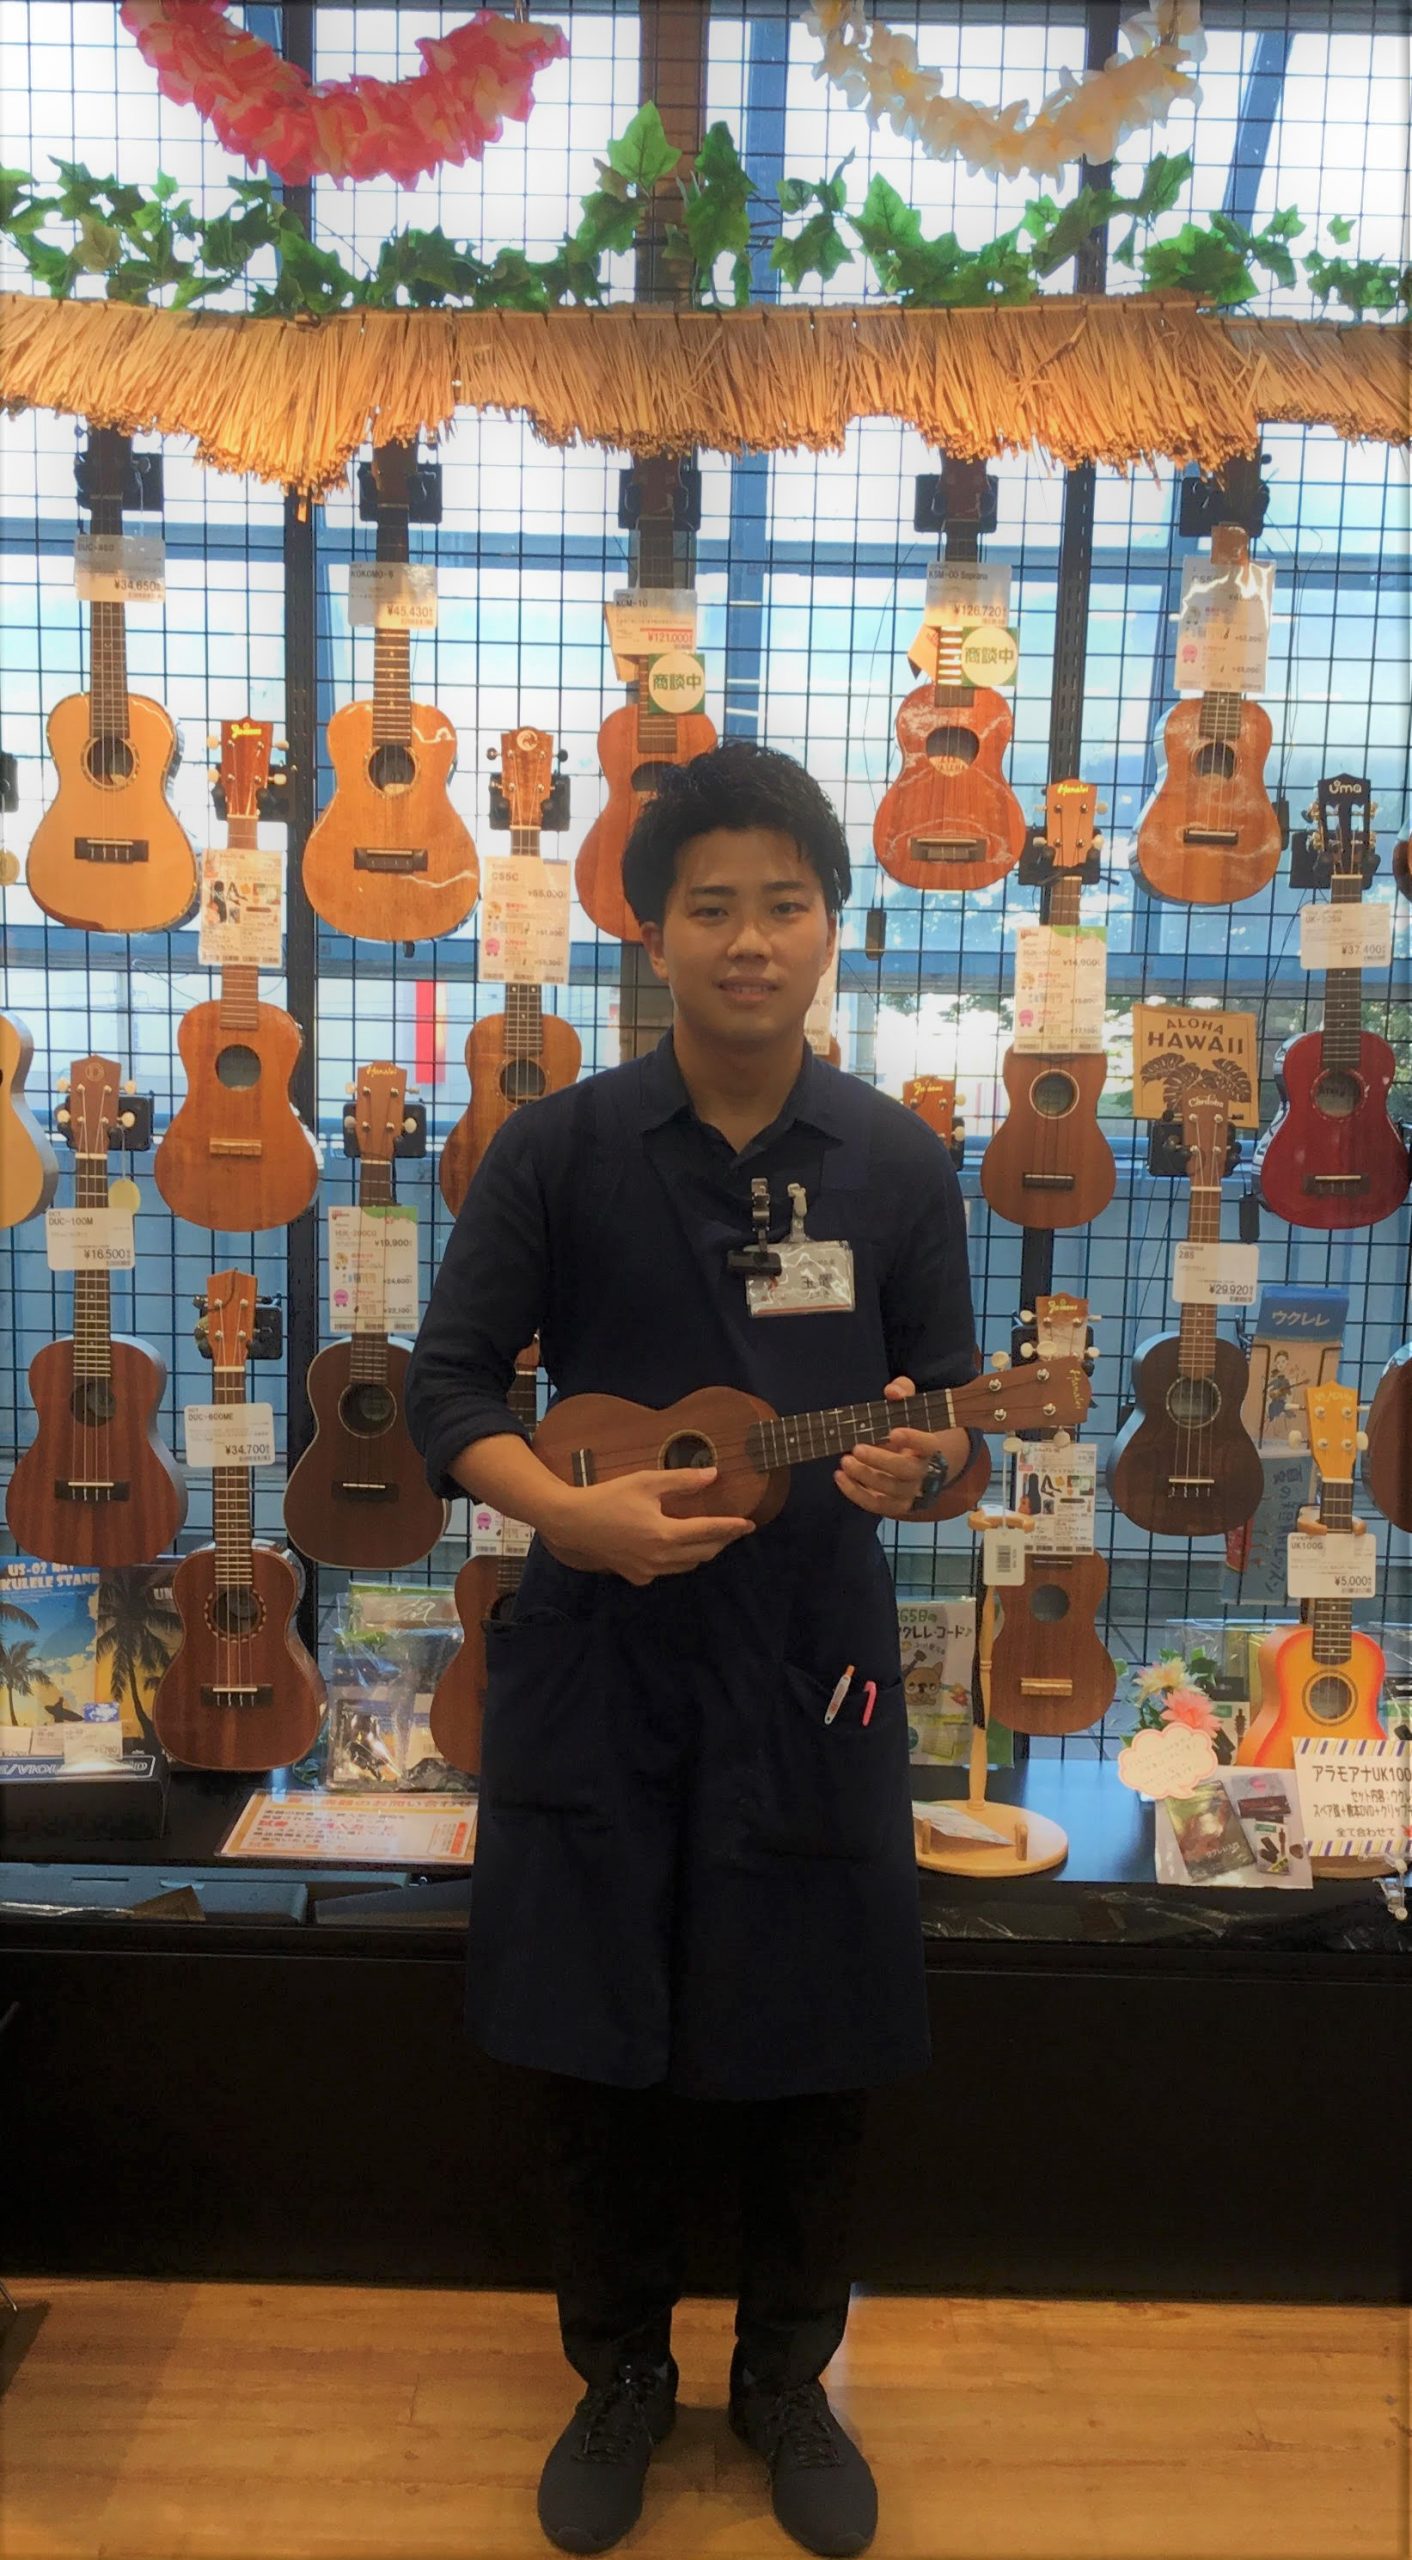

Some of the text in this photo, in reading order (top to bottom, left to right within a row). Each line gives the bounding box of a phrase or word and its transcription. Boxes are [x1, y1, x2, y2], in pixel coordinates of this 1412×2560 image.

[964, 647, 1014, 664] 商談中
[652, 673, 701, 690] 商談中
[1166, 1018, 1224, 1035] ALOHA
[1148, 1031, 1244, 1055] HAWAII
[1271, 1310, 1330, 1327] ウクレレ
[56, 1573, 100, 1588] STAND
[1336, 1827, 1396, 1838] 全て合わせて
